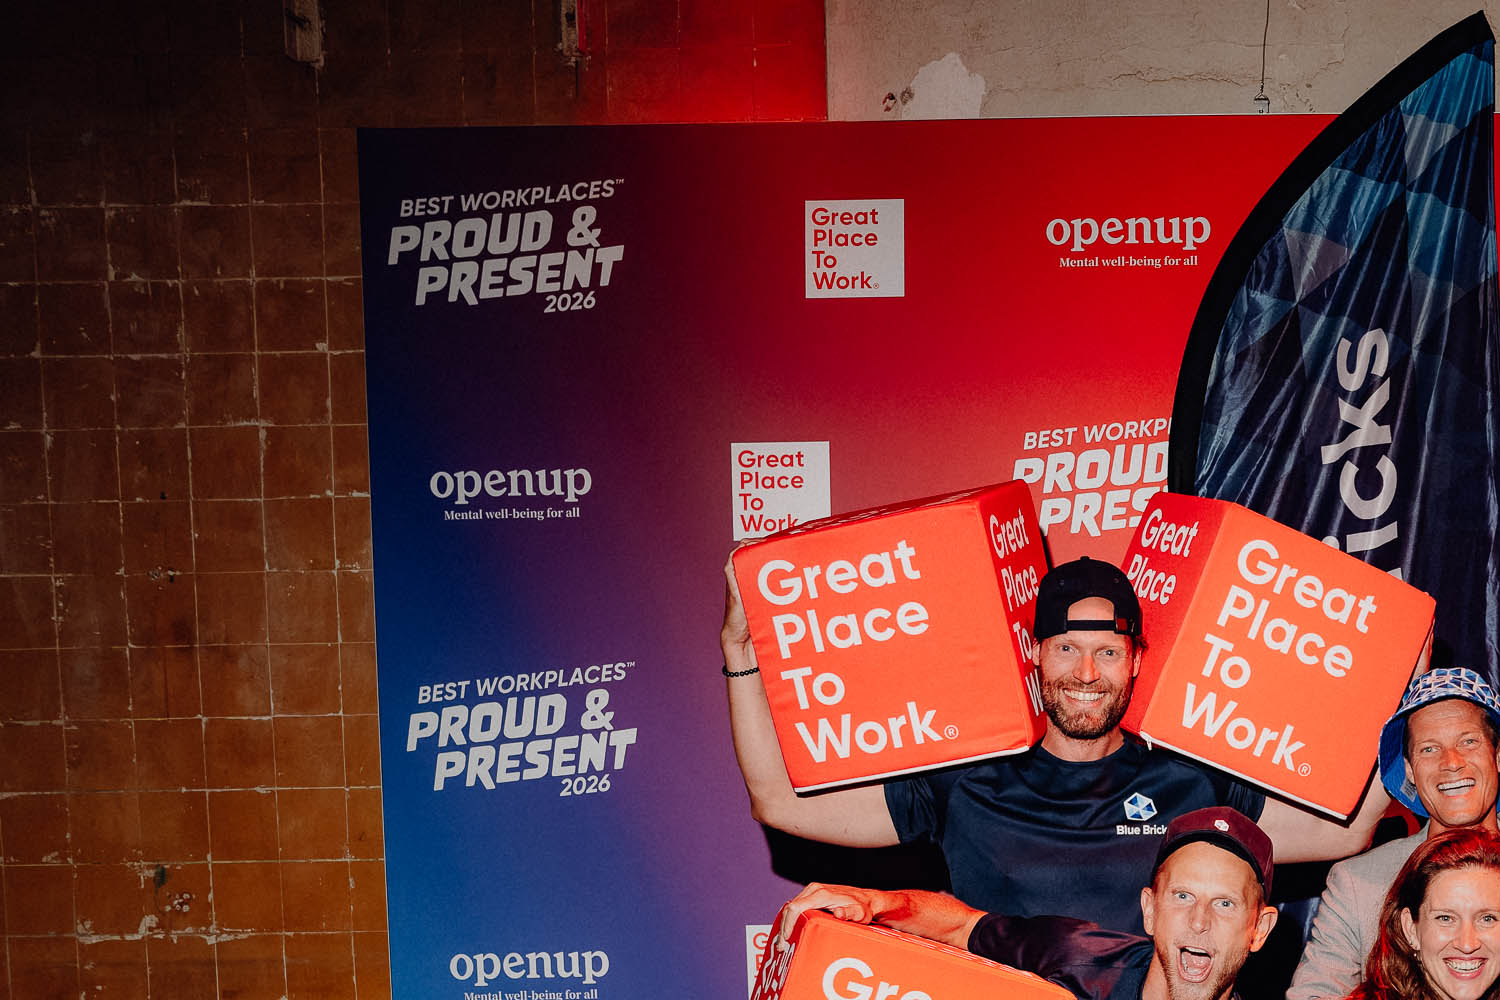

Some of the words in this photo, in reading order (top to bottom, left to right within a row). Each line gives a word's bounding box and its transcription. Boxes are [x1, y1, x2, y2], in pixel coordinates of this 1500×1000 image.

[401, 196, 454, 217] BEST
[812, 208, 877, 225] Great
[388, 210, 553, 265] PROUD
[567, 206, 601, 247] &
[814, 229, 877, 247] Place
[1046, 217, 1210, 251] openup
[812, 251, 837, 268] To
[1059, 257, 1099, 268] Mental
[1101, 256, 1161, 269] well-being
[1164, 256, 1181, 265] for
[1184, 256, 1197, 265] all
[416, 245, 624, 305] PRESENT
[544, 291, 595, 313] 2026
[1024, 427, 1077, 450] BEST
[1321, 328, 1400, 555] icks
[738, 450, 803, 468] Great
[430, 469, 591, 504] openup
[741, 472, 803, 489] Place
[739, 493, 763, 510] To
[445, 509, 483, 520] Mental
[485, 508, 545, 521] well-being
[547, 508, 563, 517] for
[566, 507, 579, 517] all
[757, 538, 921, 605] Great
[1237, 539, 1378, 634] Great
[773, 601, 930, 659] Place
[1218, 586, 1354, 679] Place
[1200, 634, 1252, 690] To
[419, 681, 470, 704] BEST
[781, 667, 845, 711] To
[407, 694, 567, 751] PROUD
[581, 689, 614, 730] &
[434, 728, 637, 790] PRESENT
[560, 774, 610, 796] 2026
[1116, 824, 1141, 835] Blue
[1142, 824, 1167, 835] Brick
[450, 951, 609, 986] openup
[565, 990, 581, 999] for
[584, 989, 597, 999] all
